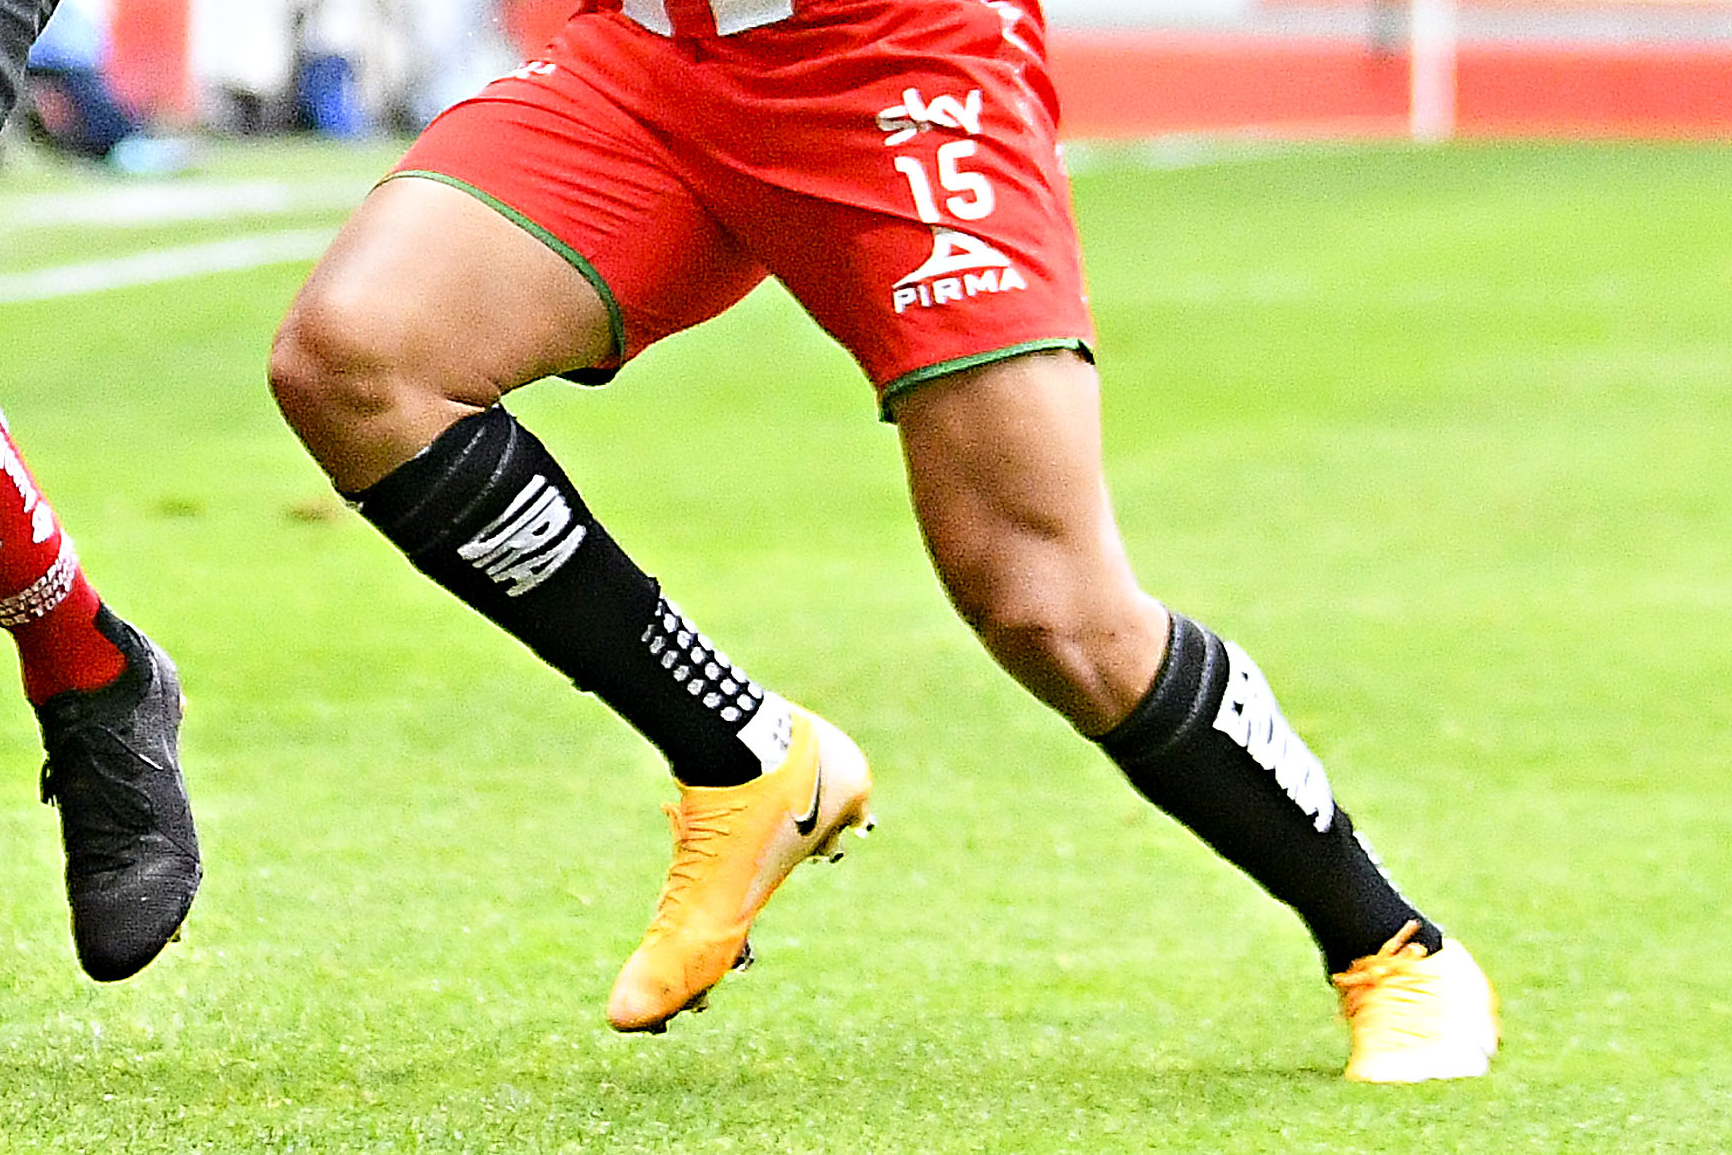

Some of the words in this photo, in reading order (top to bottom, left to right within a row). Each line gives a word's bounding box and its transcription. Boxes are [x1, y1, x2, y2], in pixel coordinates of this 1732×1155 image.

[876, 88, 982, 146] sky
[893, 140, 995, 224] 15
[892, 267, 1027, 314] PIRMA
